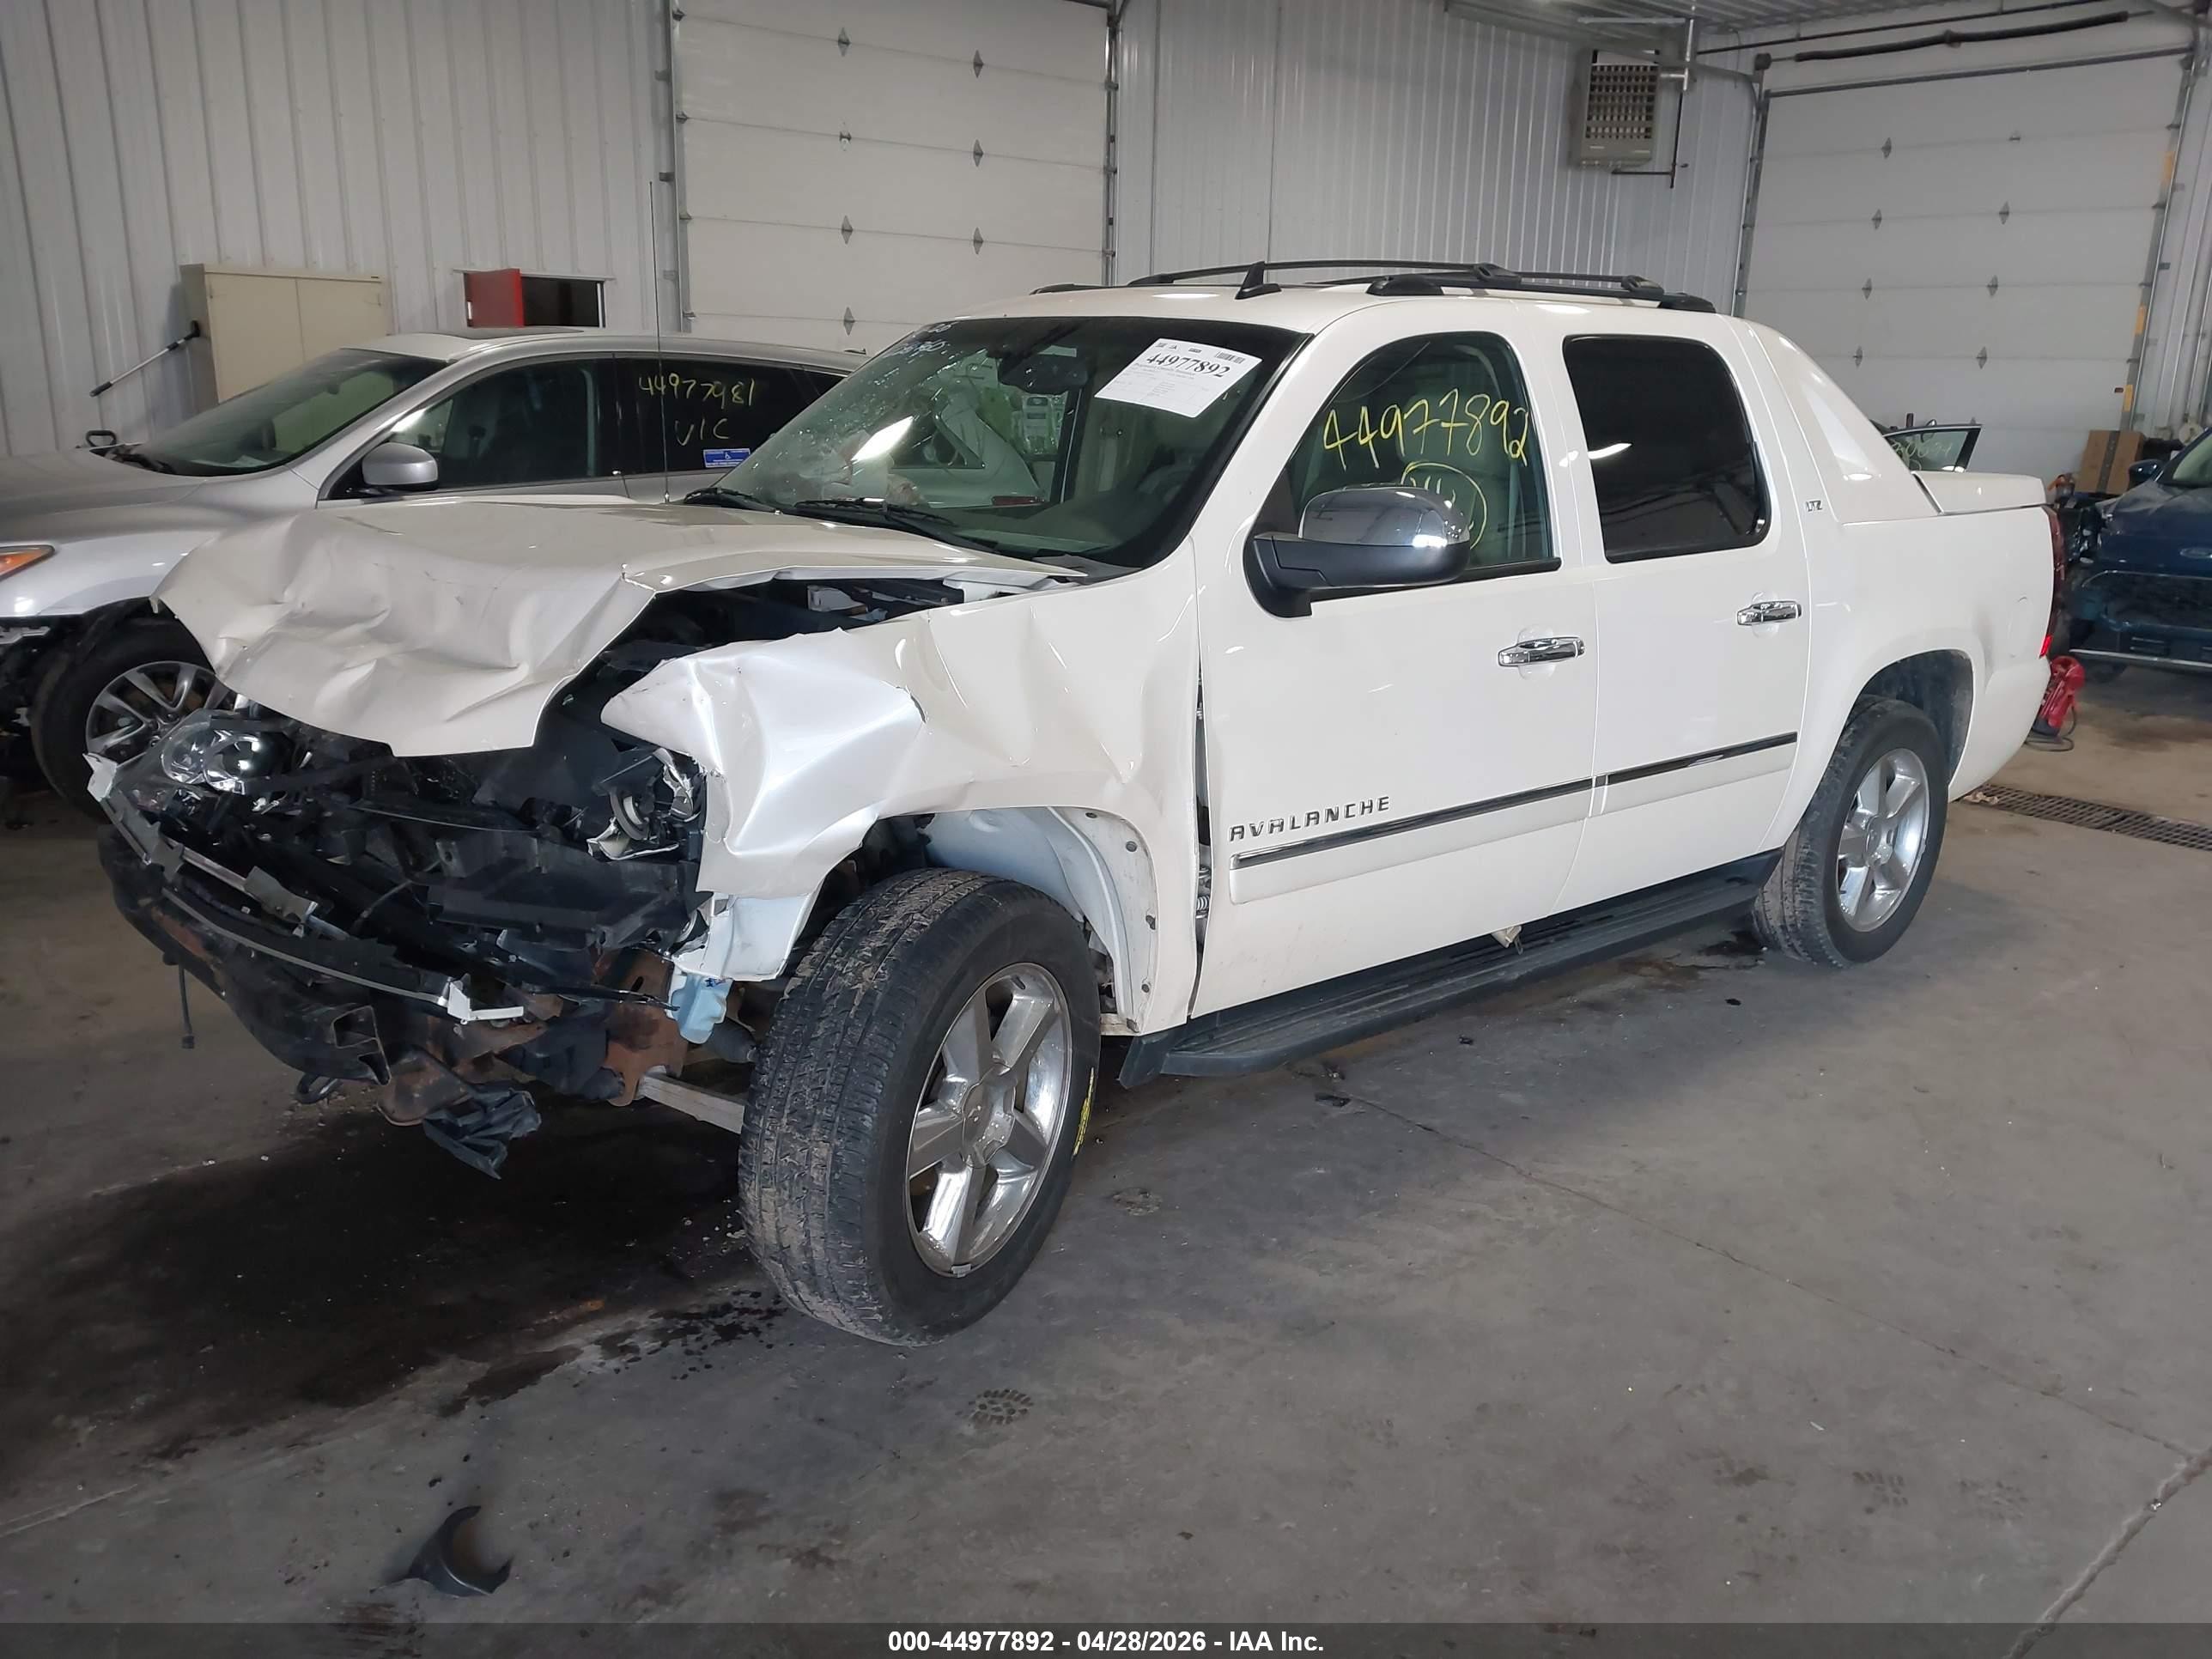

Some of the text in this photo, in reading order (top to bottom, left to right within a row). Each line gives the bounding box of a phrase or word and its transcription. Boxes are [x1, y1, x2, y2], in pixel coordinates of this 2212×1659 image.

[1146, 353, 1230, 377] 44977892
[1322, 387, 1529, 471] 44977892
[1805, 500, 1823, 512] LTZ
[1229, 795, 1390, 842] AVALANCHE
